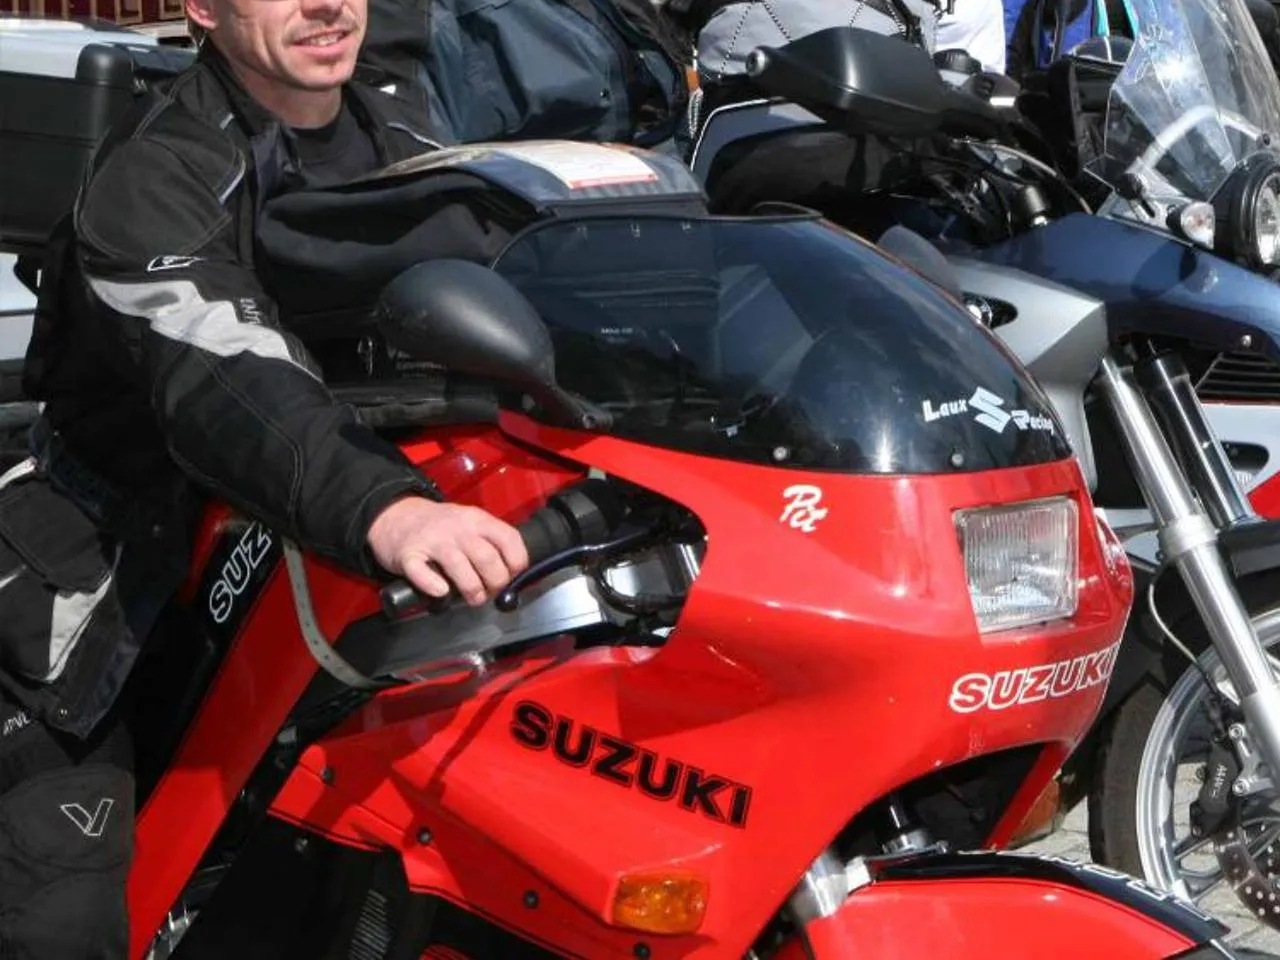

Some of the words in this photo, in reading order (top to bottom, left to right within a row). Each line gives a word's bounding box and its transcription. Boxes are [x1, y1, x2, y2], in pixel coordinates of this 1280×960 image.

[922, 399, 968, 423] Laux
[208, 519, 273, 624] SUZ
[949, 641, 1121, 714] SUZUKI
[509, 700, 753, 829] SUZUKI
